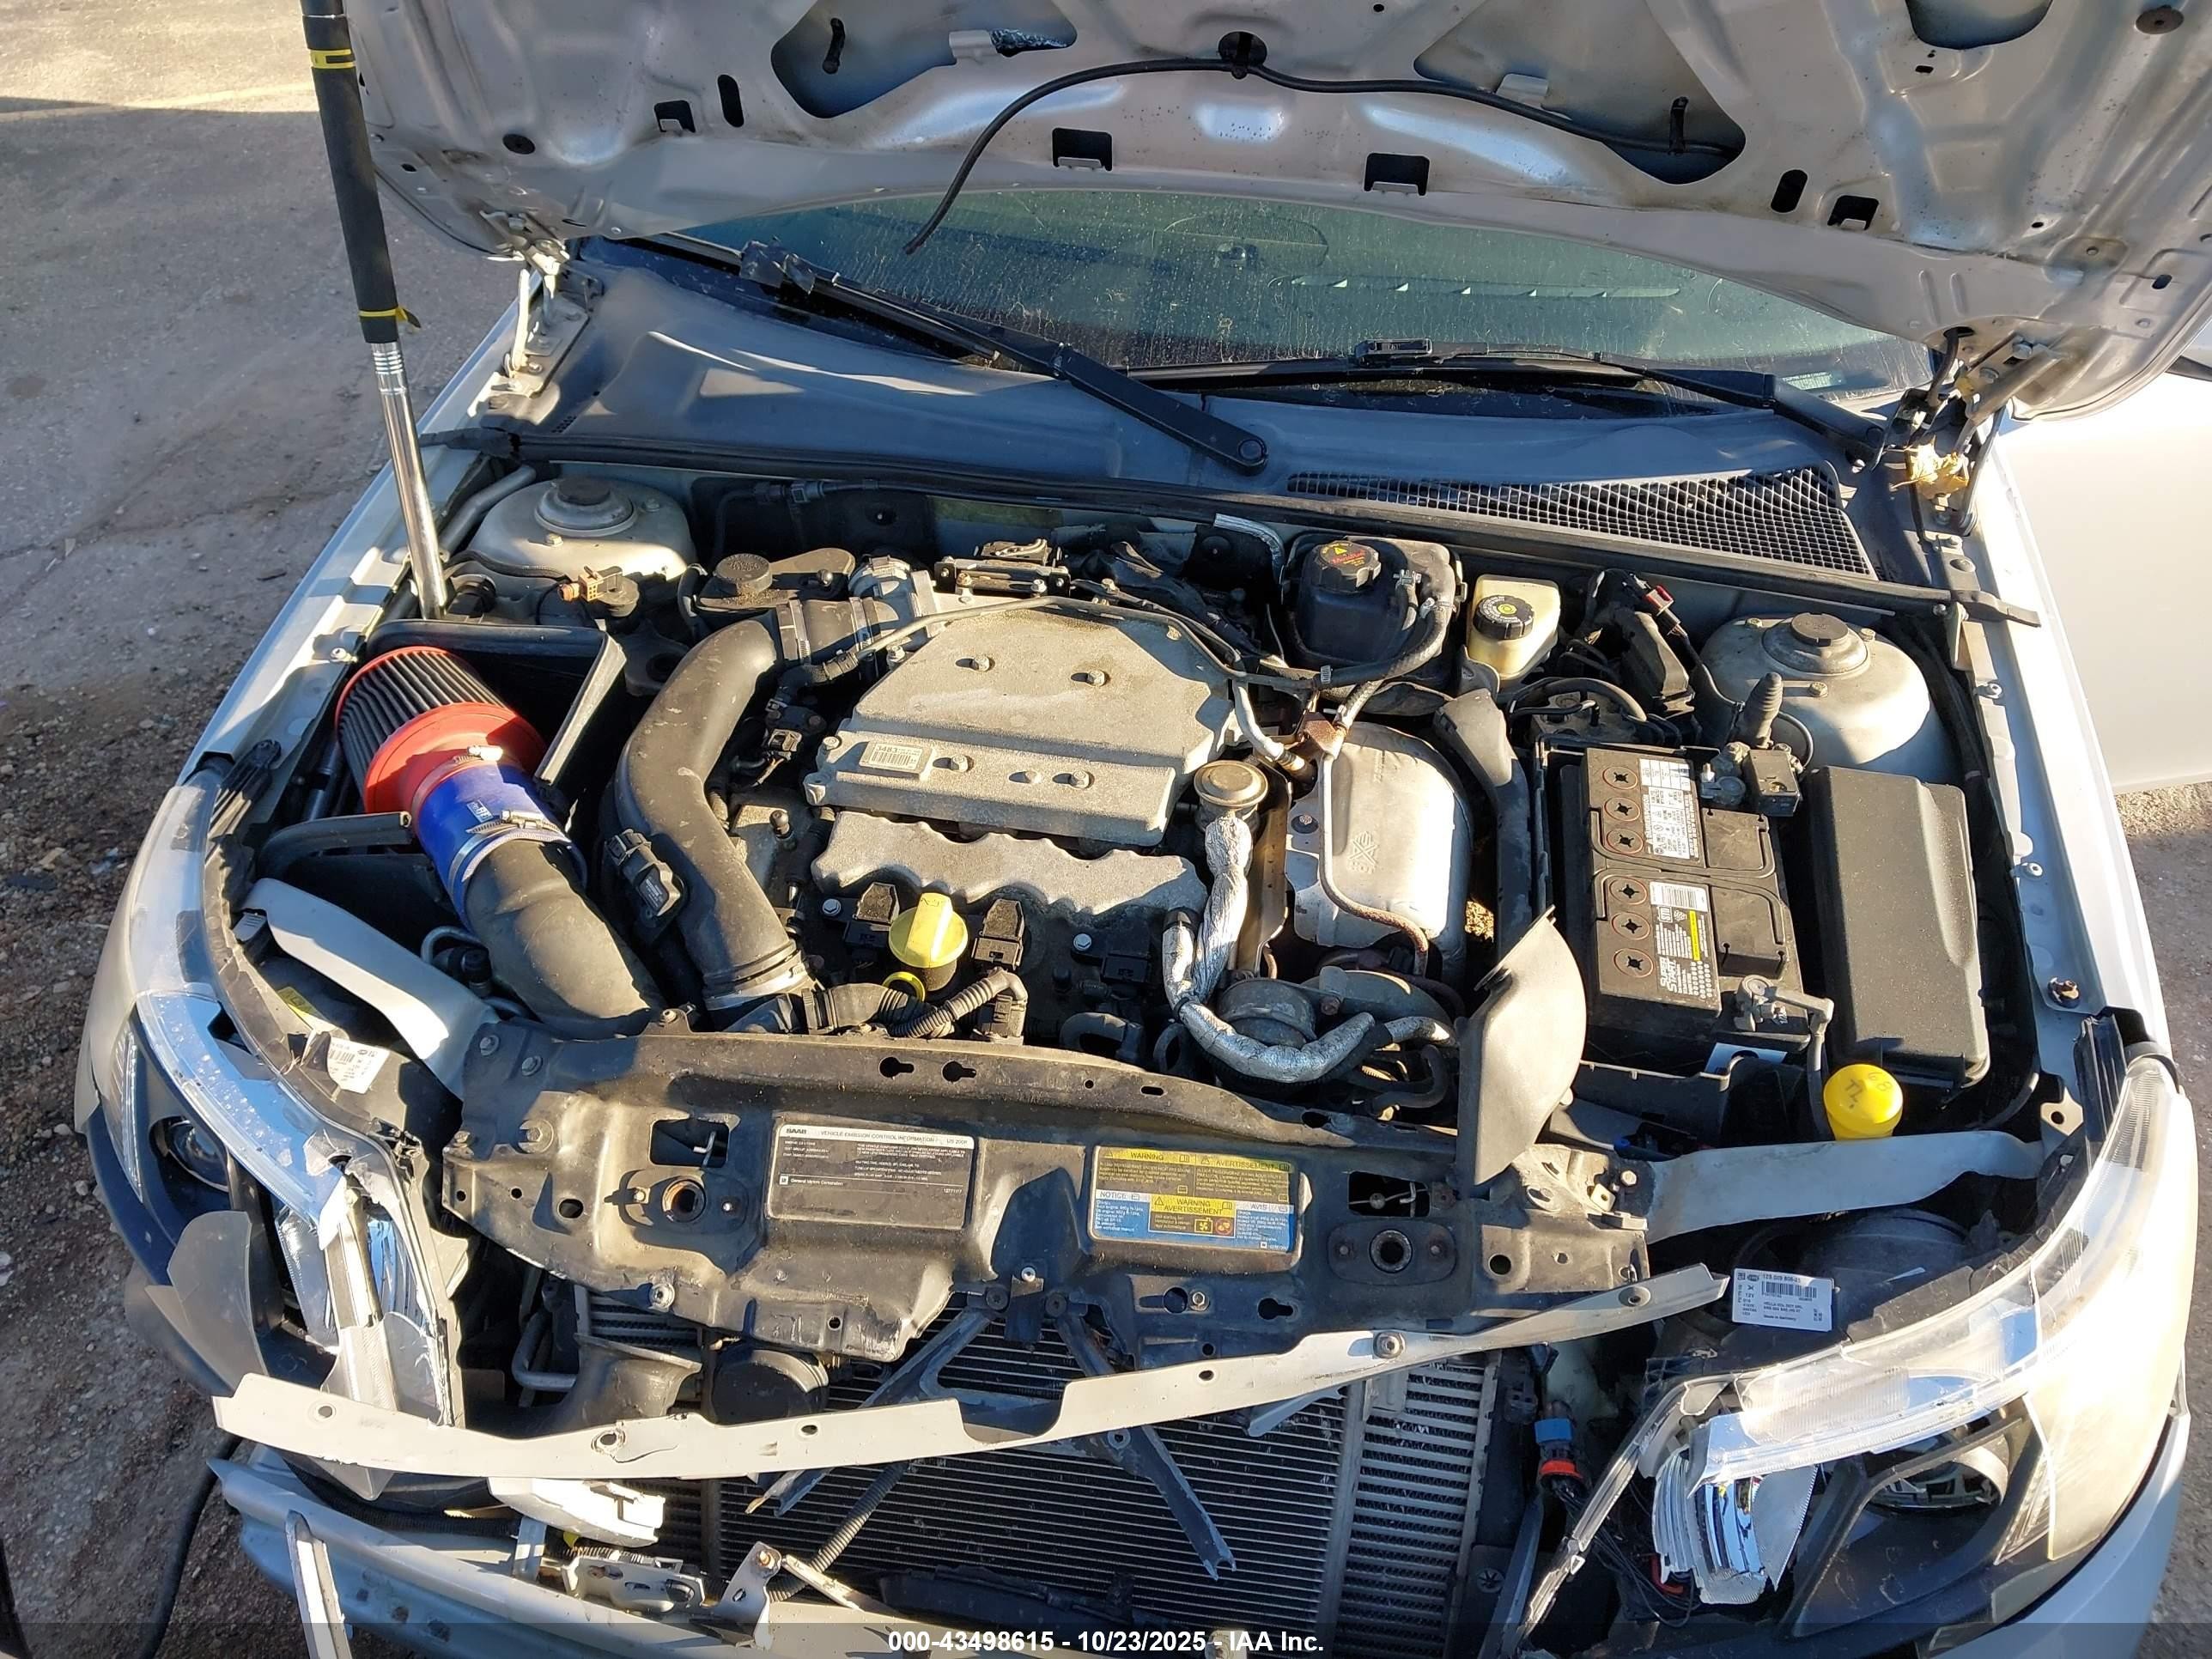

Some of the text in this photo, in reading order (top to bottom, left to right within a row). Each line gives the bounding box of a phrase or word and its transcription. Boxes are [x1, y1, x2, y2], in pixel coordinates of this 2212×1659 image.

[1659, 956, 1668, 987] SUPER
[1666, 956, 1678, 993] START
[786, 1127, 807, 1136] SAAB
[871, 1133, 897, 1141] CONTROL
[897, 1134, 935, 1143] INFORMATION
[1130, 1152, 1164, 1161] WARNING
[1216, 1159, 1276, 1170] AVERTISSEMENT
[1100, 1191, 1127, 1200] NOTICE
[1176, 1198, 1211, 1207] WARNING
[1250, 1202, 1267, 1211] AVIS
[1164, 1204, 1223, 1215] AVERTISSEMENT
